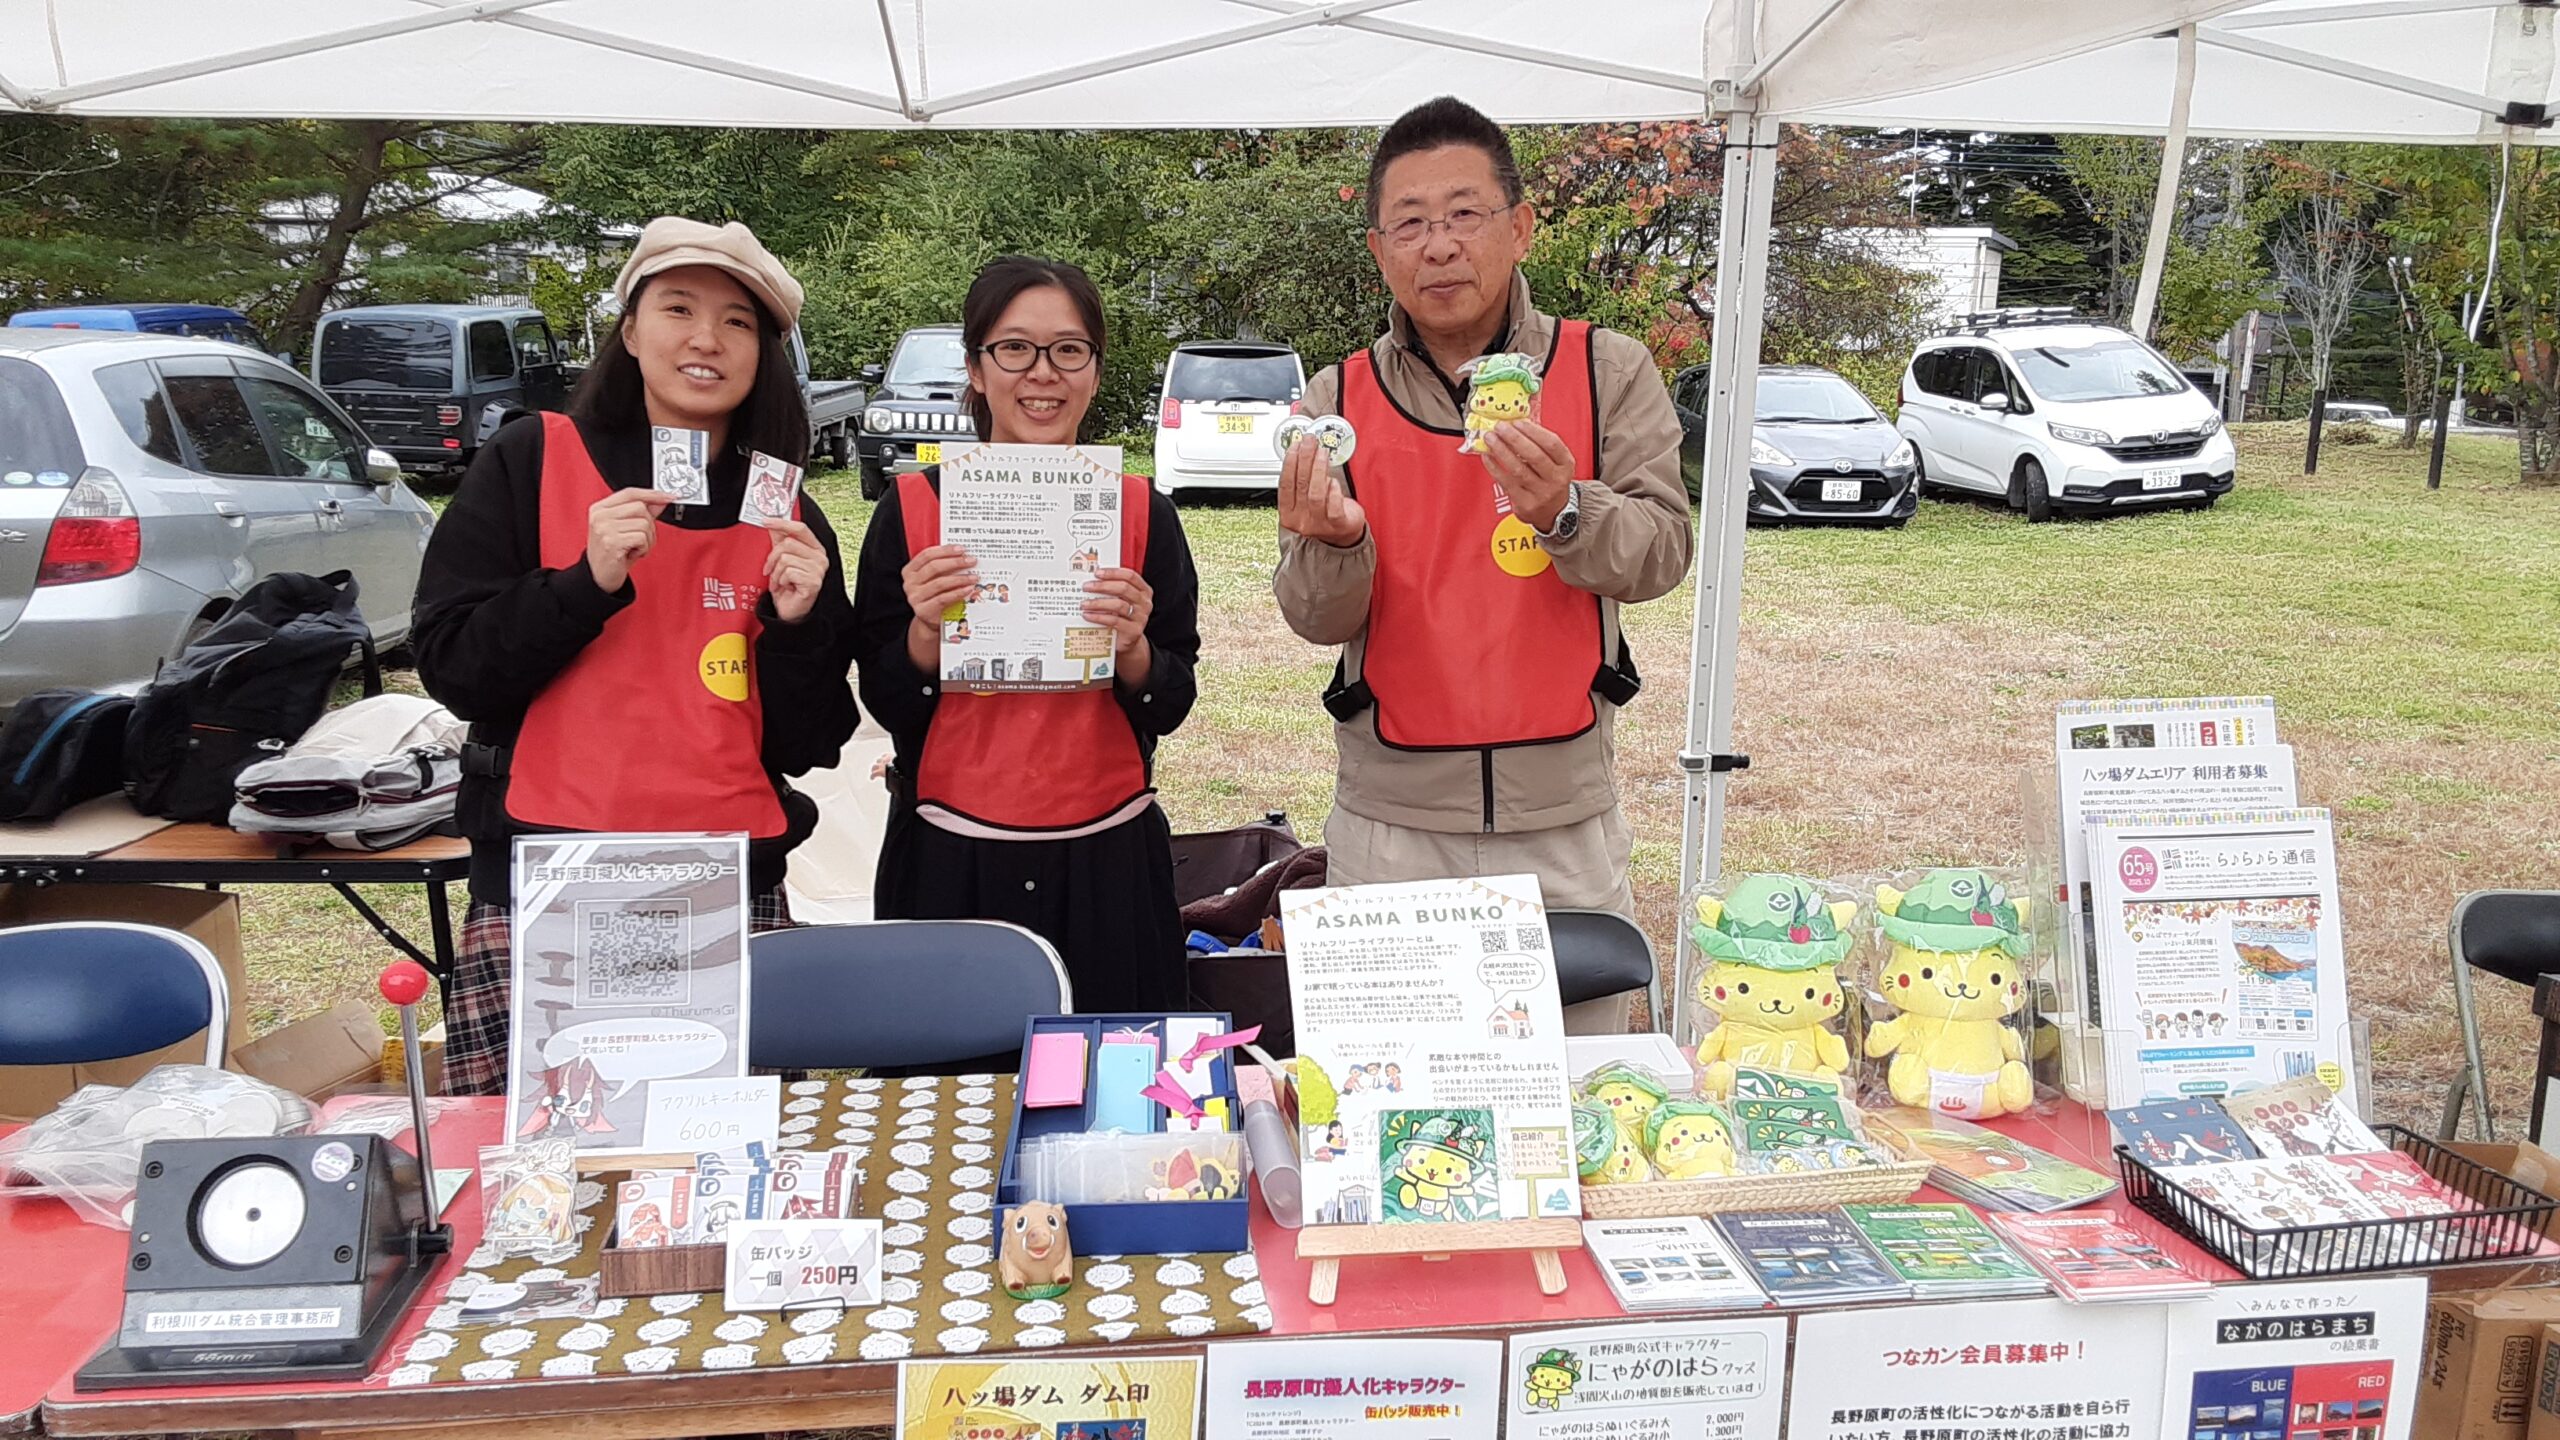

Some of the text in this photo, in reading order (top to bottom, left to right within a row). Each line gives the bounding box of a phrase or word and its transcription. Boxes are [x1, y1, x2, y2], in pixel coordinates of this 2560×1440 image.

[1225, 422, 1250, 432] 34-91
[961, 470, 1094, 484] ASAMA BUNKO
[2152, 476, 2179, 488] 33-22
[948, 492, 1042, 500] リトルフリーライブラリーとは
[1830, 488, 1859, 500] 85-60
[2082, 764, 2268, 782] 八ッ場ダムエリア 利用者募集
[534, 862, 737, 883] 長野原町擬人化キャラクター
[1342, 891, 1475, 906] リトルフリーライブラリー
[1316, 905, 1504, 930] ASAMA BUNKO
[1300, 935, 1434, 949] リトルフリーライブラリーとは
[1428, 1052, 1502, 1062] 素敵な本や仲間との
[1429, 1062, 1560, 1074] 出会いがまっているかもしれません
[660, 1088, 770, 1111] アクリルキーホルダー
[680, 1116, 740, 1140] 600円
[1512, 1132, 1544, 1141] 自己紹介
[1808, 1234, 1854, 1242] BLUE
[1924, 1227, 1983, 1235] GREEN
[2102, 1234, 2138, 1242] RED
[751, 1246, 813, 1262] 缶バッジ
[1656, 1242, 1712, 1252] WHITE
[750, 1265, 858, 1286] 一個 250円
[2251, 1296, 2346, 1312] みんなで作った
[151, 1312, 336, 1330] 利根川ダム統合管理事務所
[2223, 1318, 2370, 1341] ながのはらまち
[1589, 1338, 1733, 1357] 長野原町公式キャラクター
[2330, 1338, 2381, 1353] の絵葉書
[1882, 1340, 2086, 1367] つなカン会員募集中！
[1244, 1377, 1466, 1400] 長野原町擬人化キャラクター
[2251, 1379, 2287, 1393] BLUE
[2358, 1375, 2386, 1388] RED
[942, 1384, 1150, 1407] 八ッ場ダム ダム印
[1364, 1404, 1461, 1420] 缶バッジ販売中！
[1830, 1399, 2131, 1425] 長野原町の活性化につながる活動を自ら行
[1539, 1412, 1744, 1436] にゃがのはらぬいぐるみ大 2,000円
